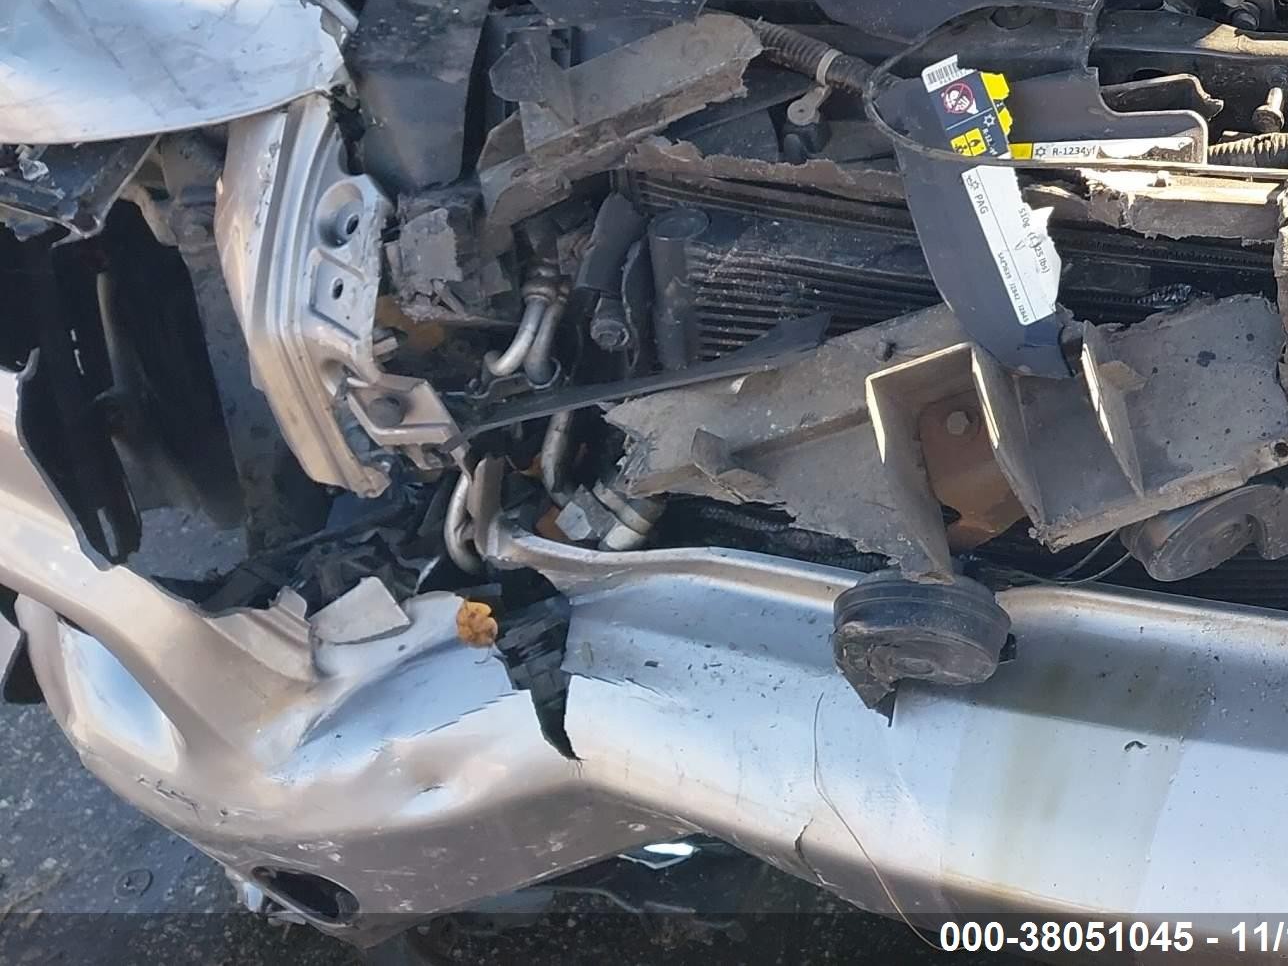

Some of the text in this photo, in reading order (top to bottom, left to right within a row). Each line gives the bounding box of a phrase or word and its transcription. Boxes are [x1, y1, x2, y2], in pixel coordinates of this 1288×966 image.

[1052, 145, 1097, 156] R-1234yf
[974, 193, 990, 215] PAG
[1018, 207, 1031, 229] 510g
